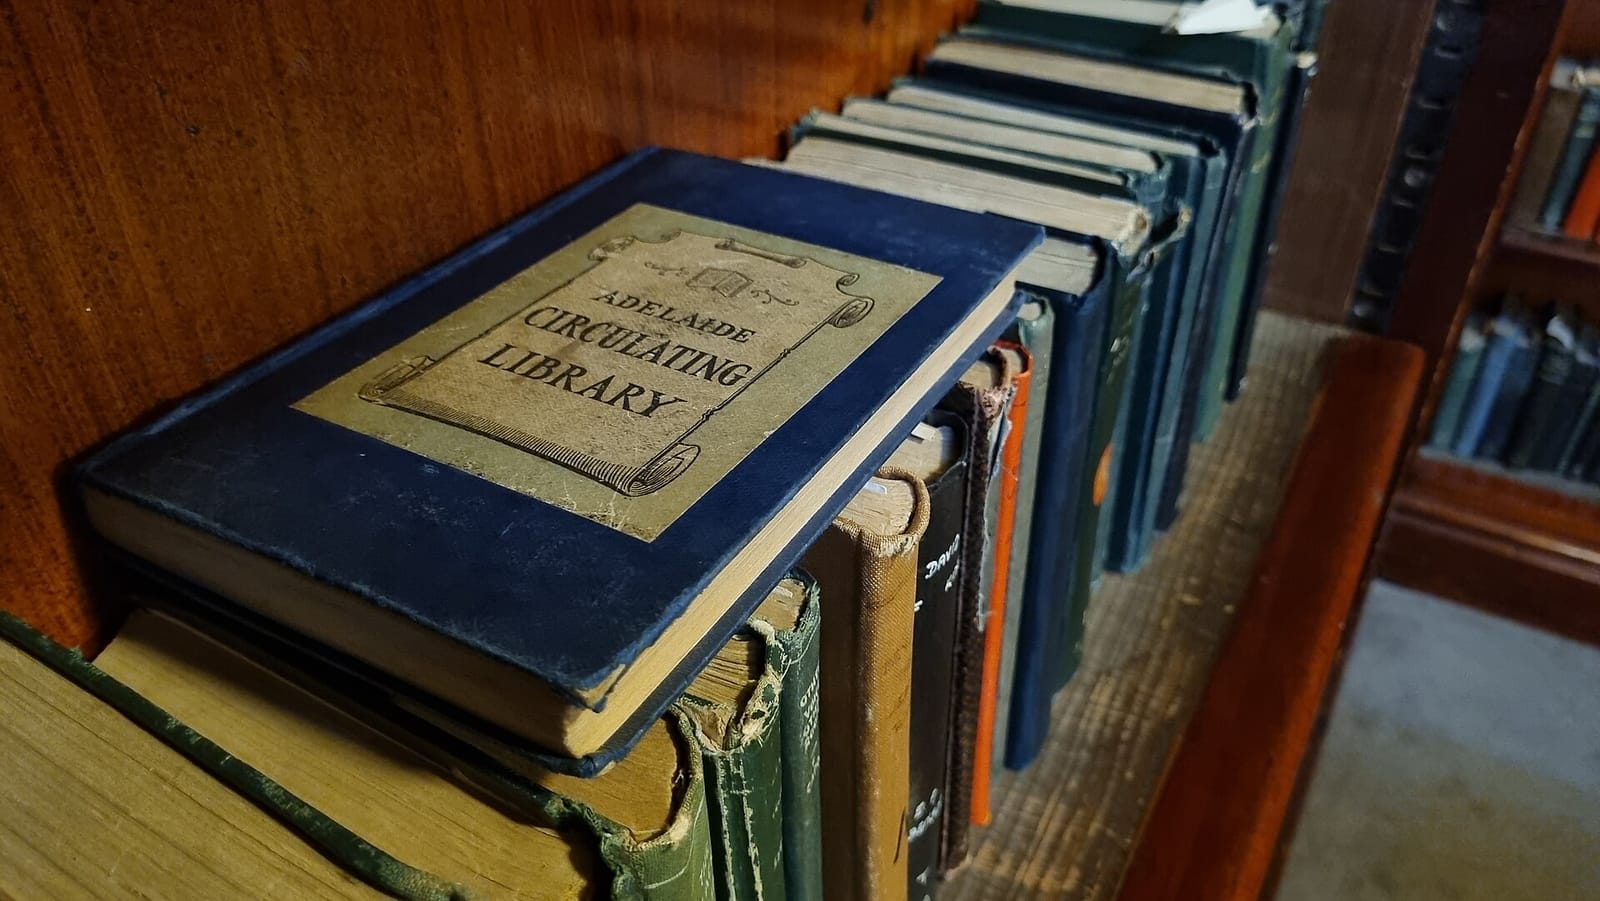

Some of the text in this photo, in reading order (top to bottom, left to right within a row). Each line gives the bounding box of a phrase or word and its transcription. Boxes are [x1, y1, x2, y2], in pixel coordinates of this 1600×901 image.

[524, 306, 753, 387] CIRCULATING
[591, 290, 756, 344] ADELAIDE
[478, 343, 689, 418] LIBRARY
